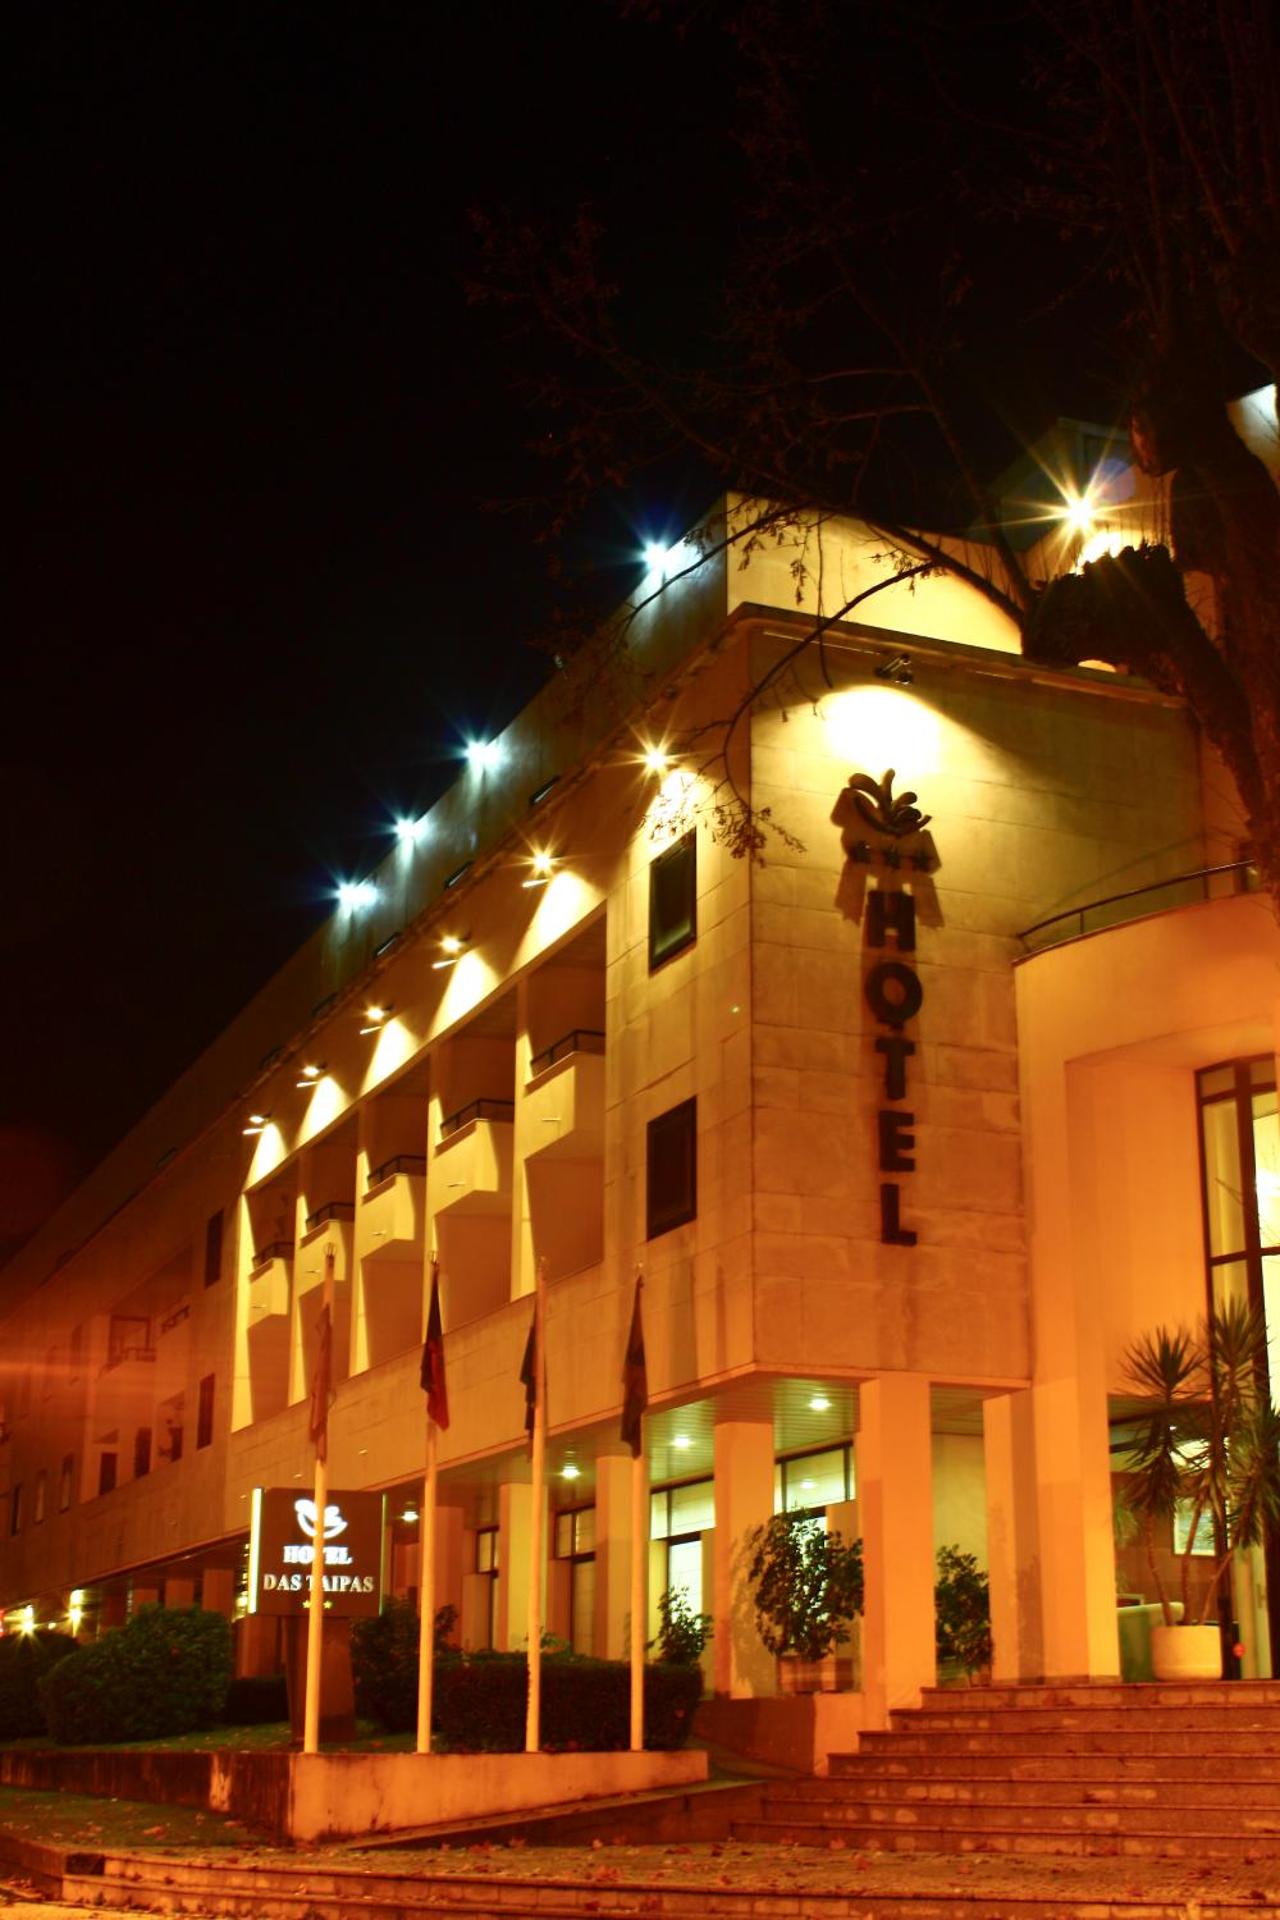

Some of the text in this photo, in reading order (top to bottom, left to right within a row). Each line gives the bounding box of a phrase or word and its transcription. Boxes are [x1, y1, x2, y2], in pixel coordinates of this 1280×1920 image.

[865, 890, 924, 1245] HOTEL
[283, 1545, 353, 1564] HOEL
[263, 1573, 302, 1591] DAS
